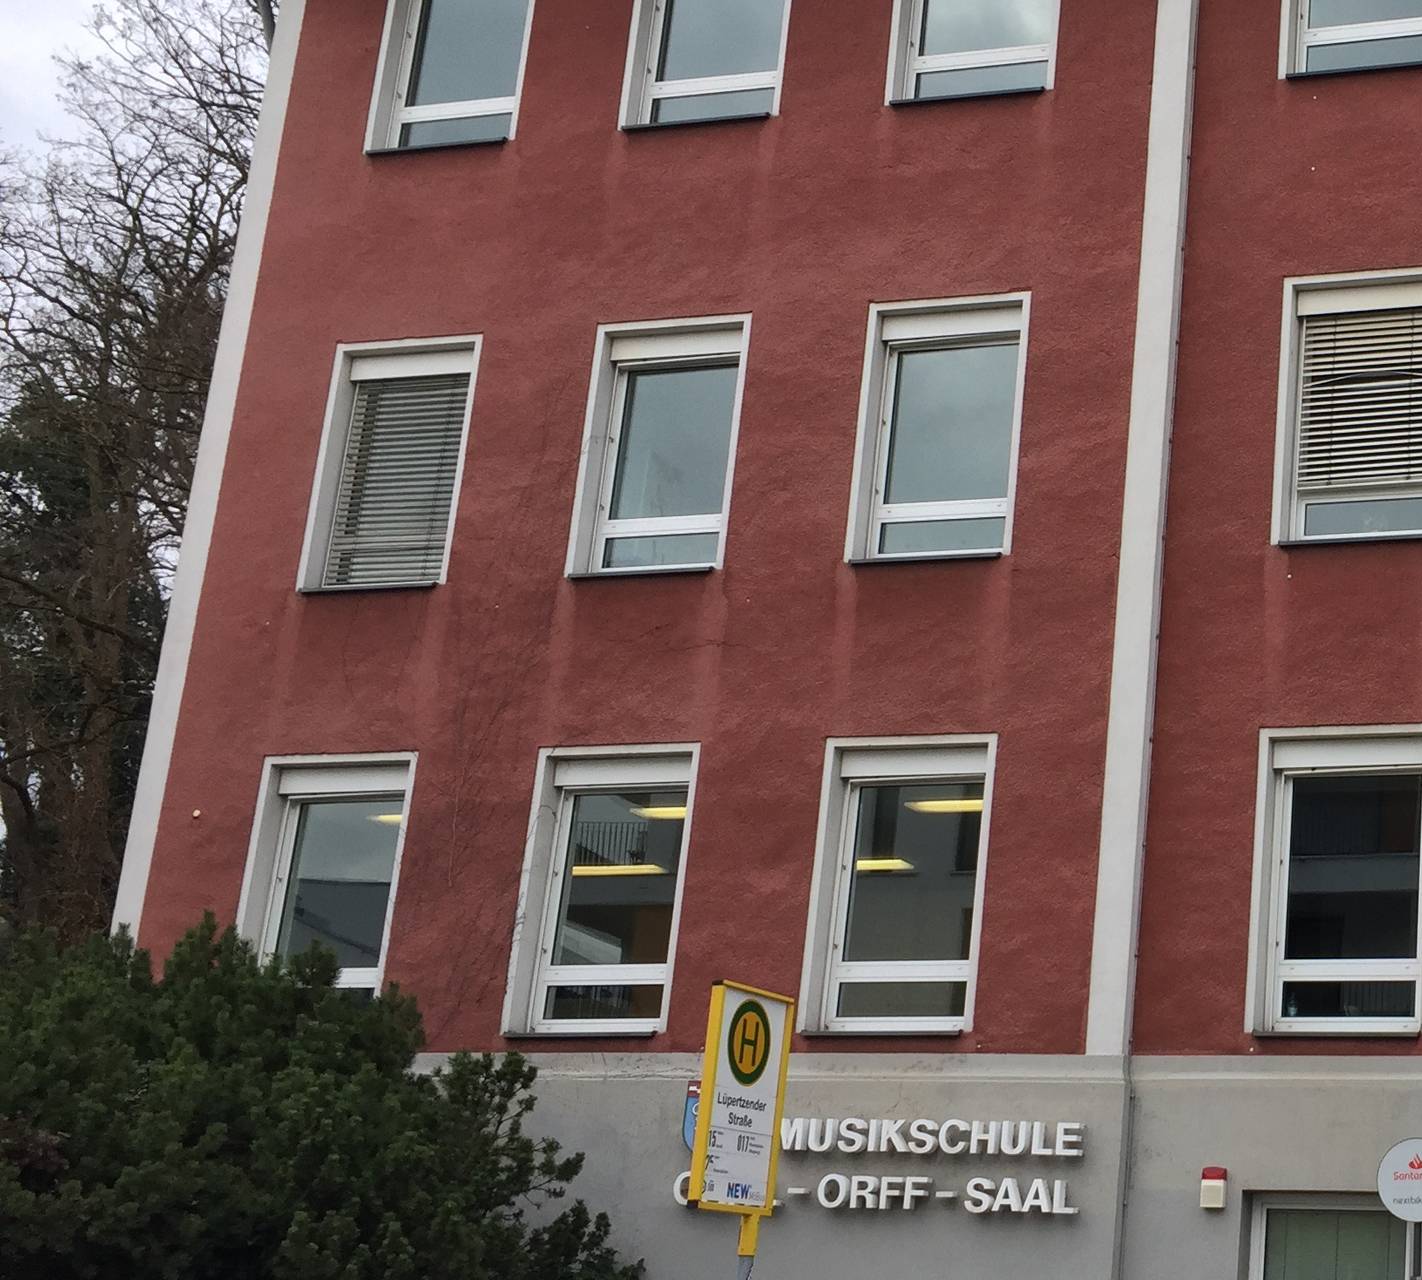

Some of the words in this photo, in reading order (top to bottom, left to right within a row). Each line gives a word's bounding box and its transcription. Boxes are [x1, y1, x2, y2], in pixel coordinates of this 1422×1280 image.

[739, 1018, 759, 1067] H
[717, 1092, 767, 1112] Lüpertzender
[728, 1112, 753, 1128] Straße
[737, 1134, 750, 1152] 017
[780, 1117, 1086, 1157] MUSIKSCHULE
[727, 1182, 750, 1200] NEW
[816, 1173, 933, 1211] ORFF
[963, 1176, 1081, 1215] SAAL
